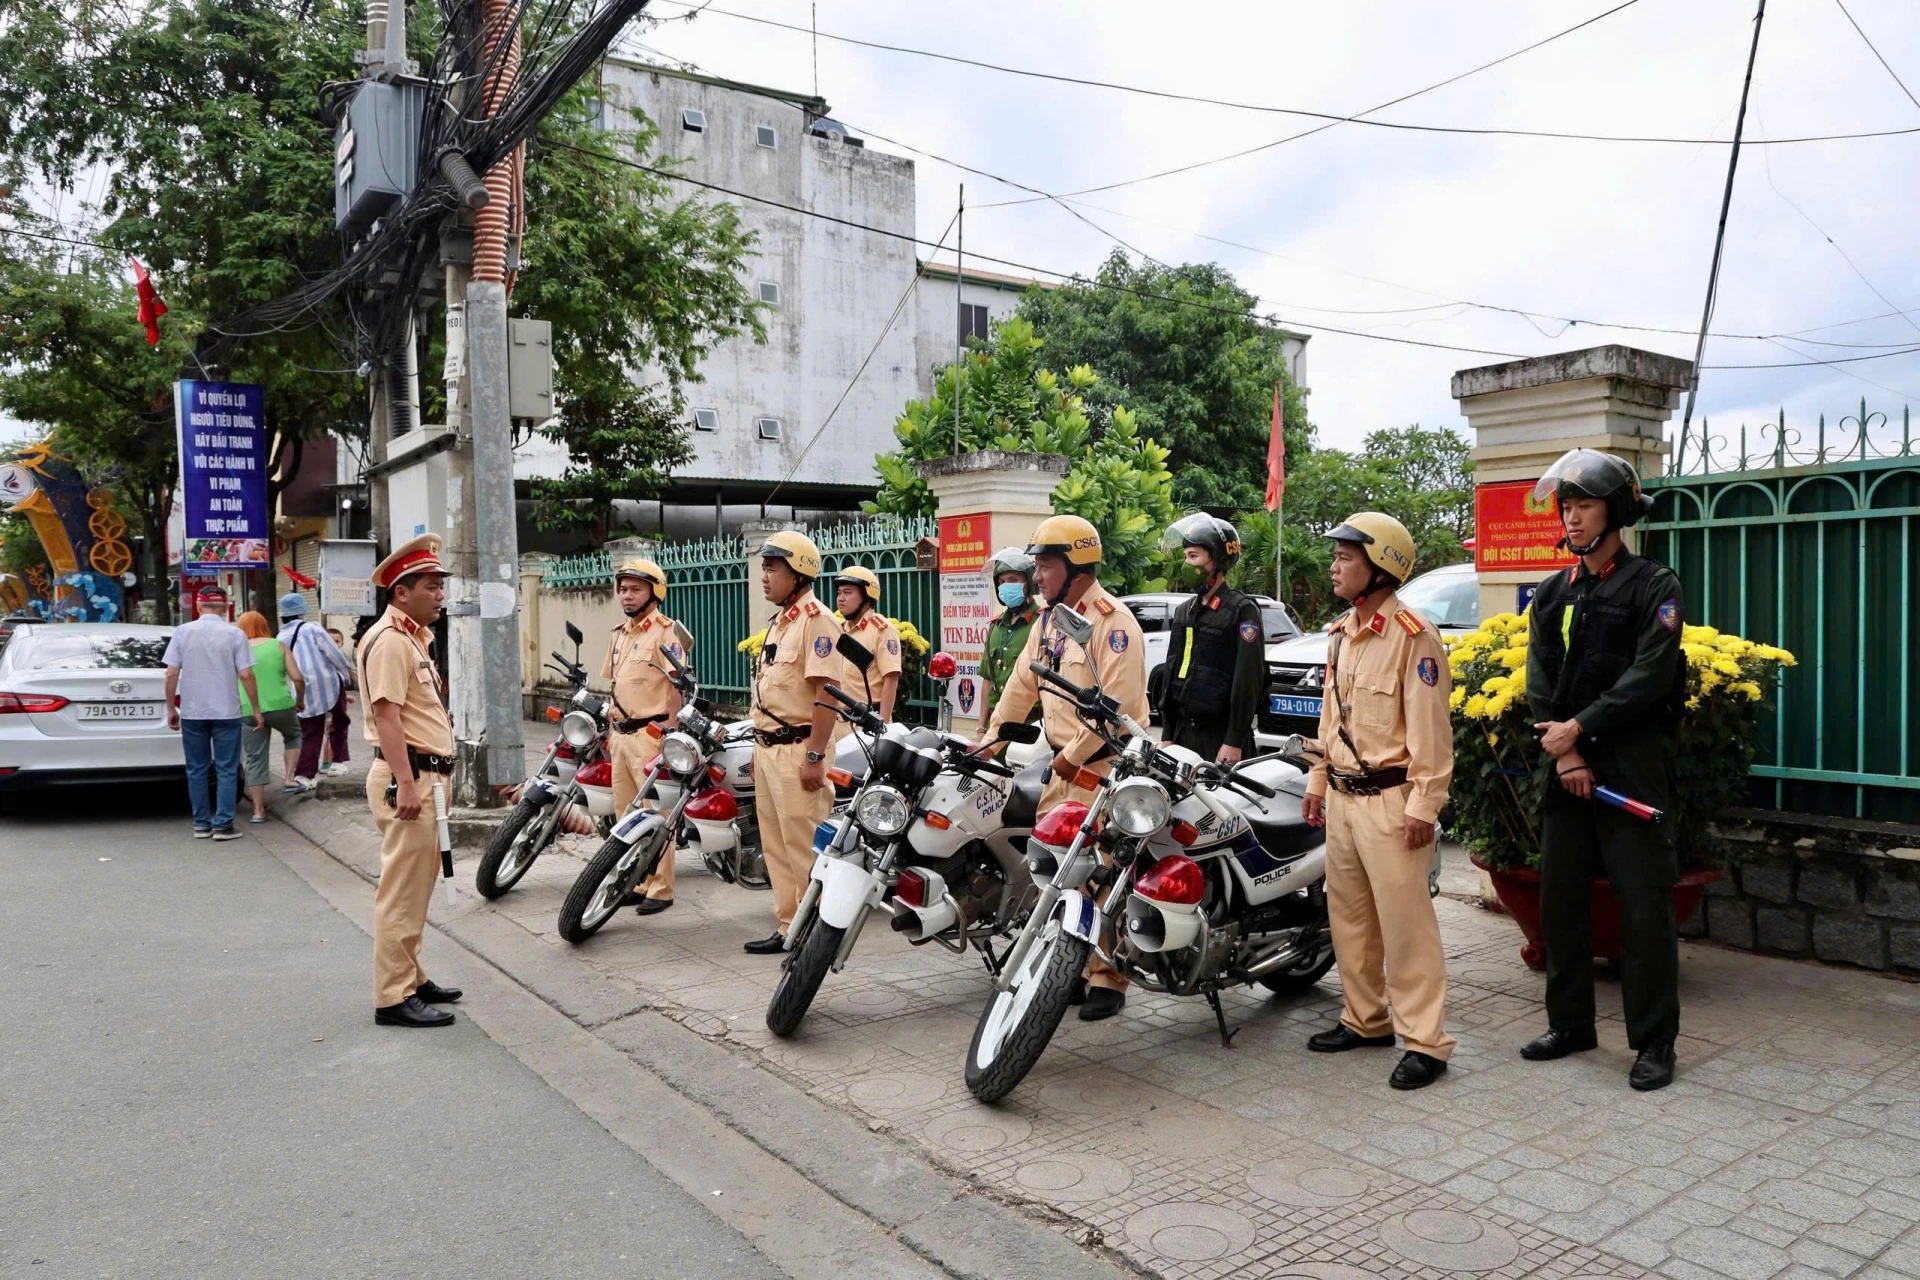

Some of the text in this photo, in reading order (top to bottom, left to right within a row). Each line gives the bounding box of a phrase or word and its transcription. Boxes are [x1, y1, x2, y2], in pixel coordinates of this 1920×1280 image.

[195, 431, 210, 447] HÃY
[228, 436, 253, 449] TRANH
[208, 453, 224, 469] CÁC
[247, 457, 255, 470] VI
[209, 477, 241, 493] VI PHẠM
[210, 496, 242, 512] AN TOÀN
[1543, 520, 1562, 528] GIAO
[800, 555, 819, 568] CSG
[1500, 547, 1522, 561] CSGT
[958, 601, 971, 618] TIẾP
[944, 627, 963, 644] TIN
[84, 706, 154, 716] 79A-012.13
[961, 784, 983, 799] HONDA
[983, 799, 1004, 818] POLICE
[1254, 865, 1291, 887] POLICE
